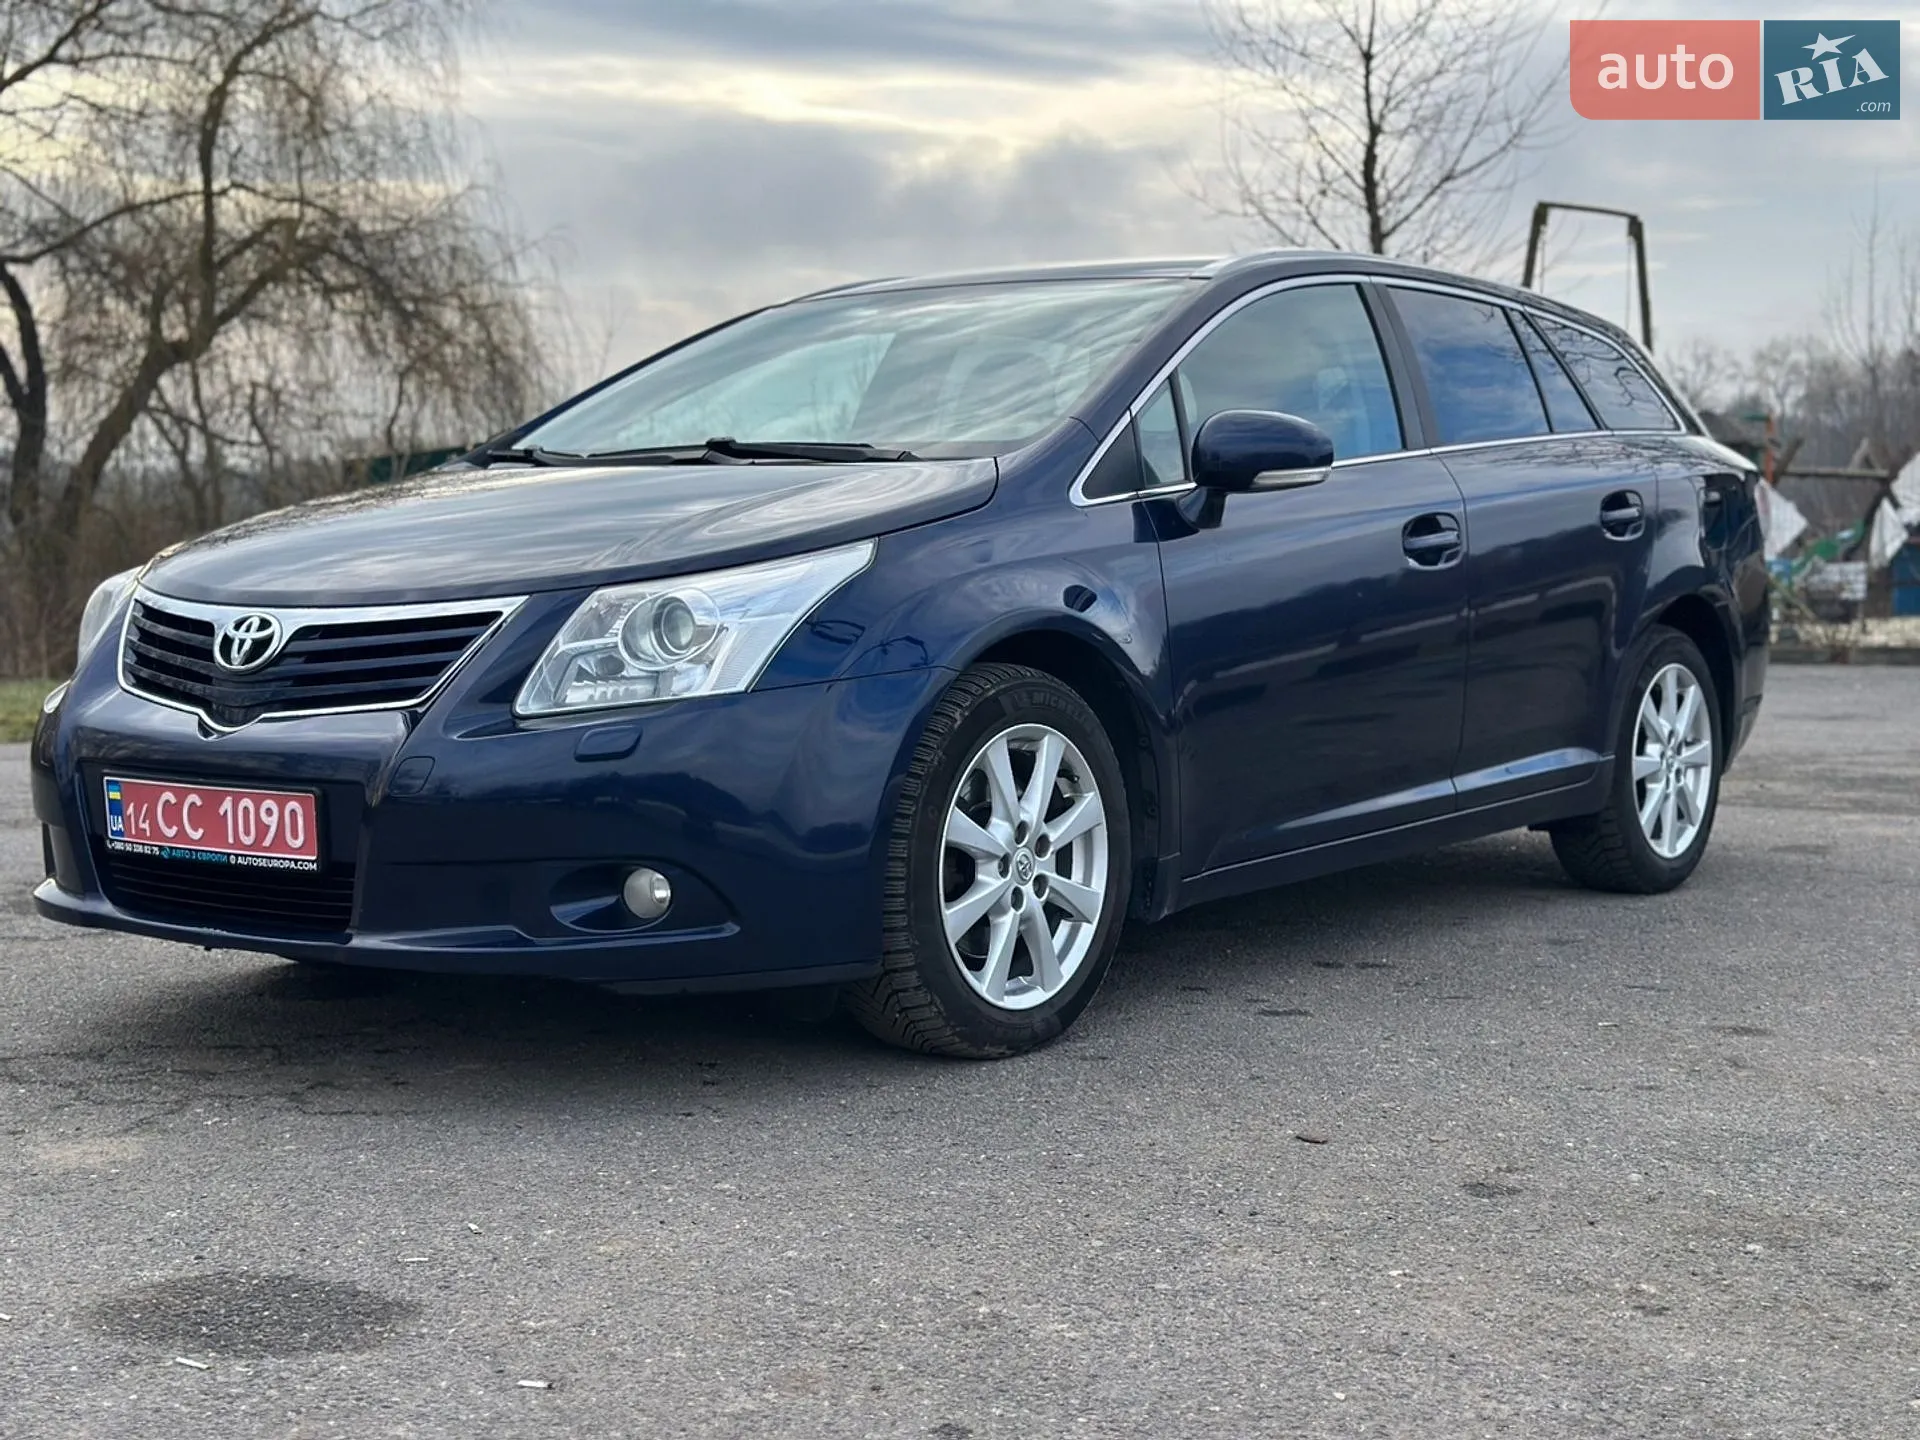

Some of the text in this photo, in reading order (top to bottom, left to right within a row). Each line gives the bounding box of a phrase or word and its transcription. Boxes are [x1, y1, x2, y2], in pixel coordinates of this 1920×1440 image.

[110, 815, 124, 832] UA
[126, 791, 305, 849] 14 CC 1090
[172, 850, 190, 860] АВТО
[237, 855, 318, 871] AUTOSEUROPA.COM
